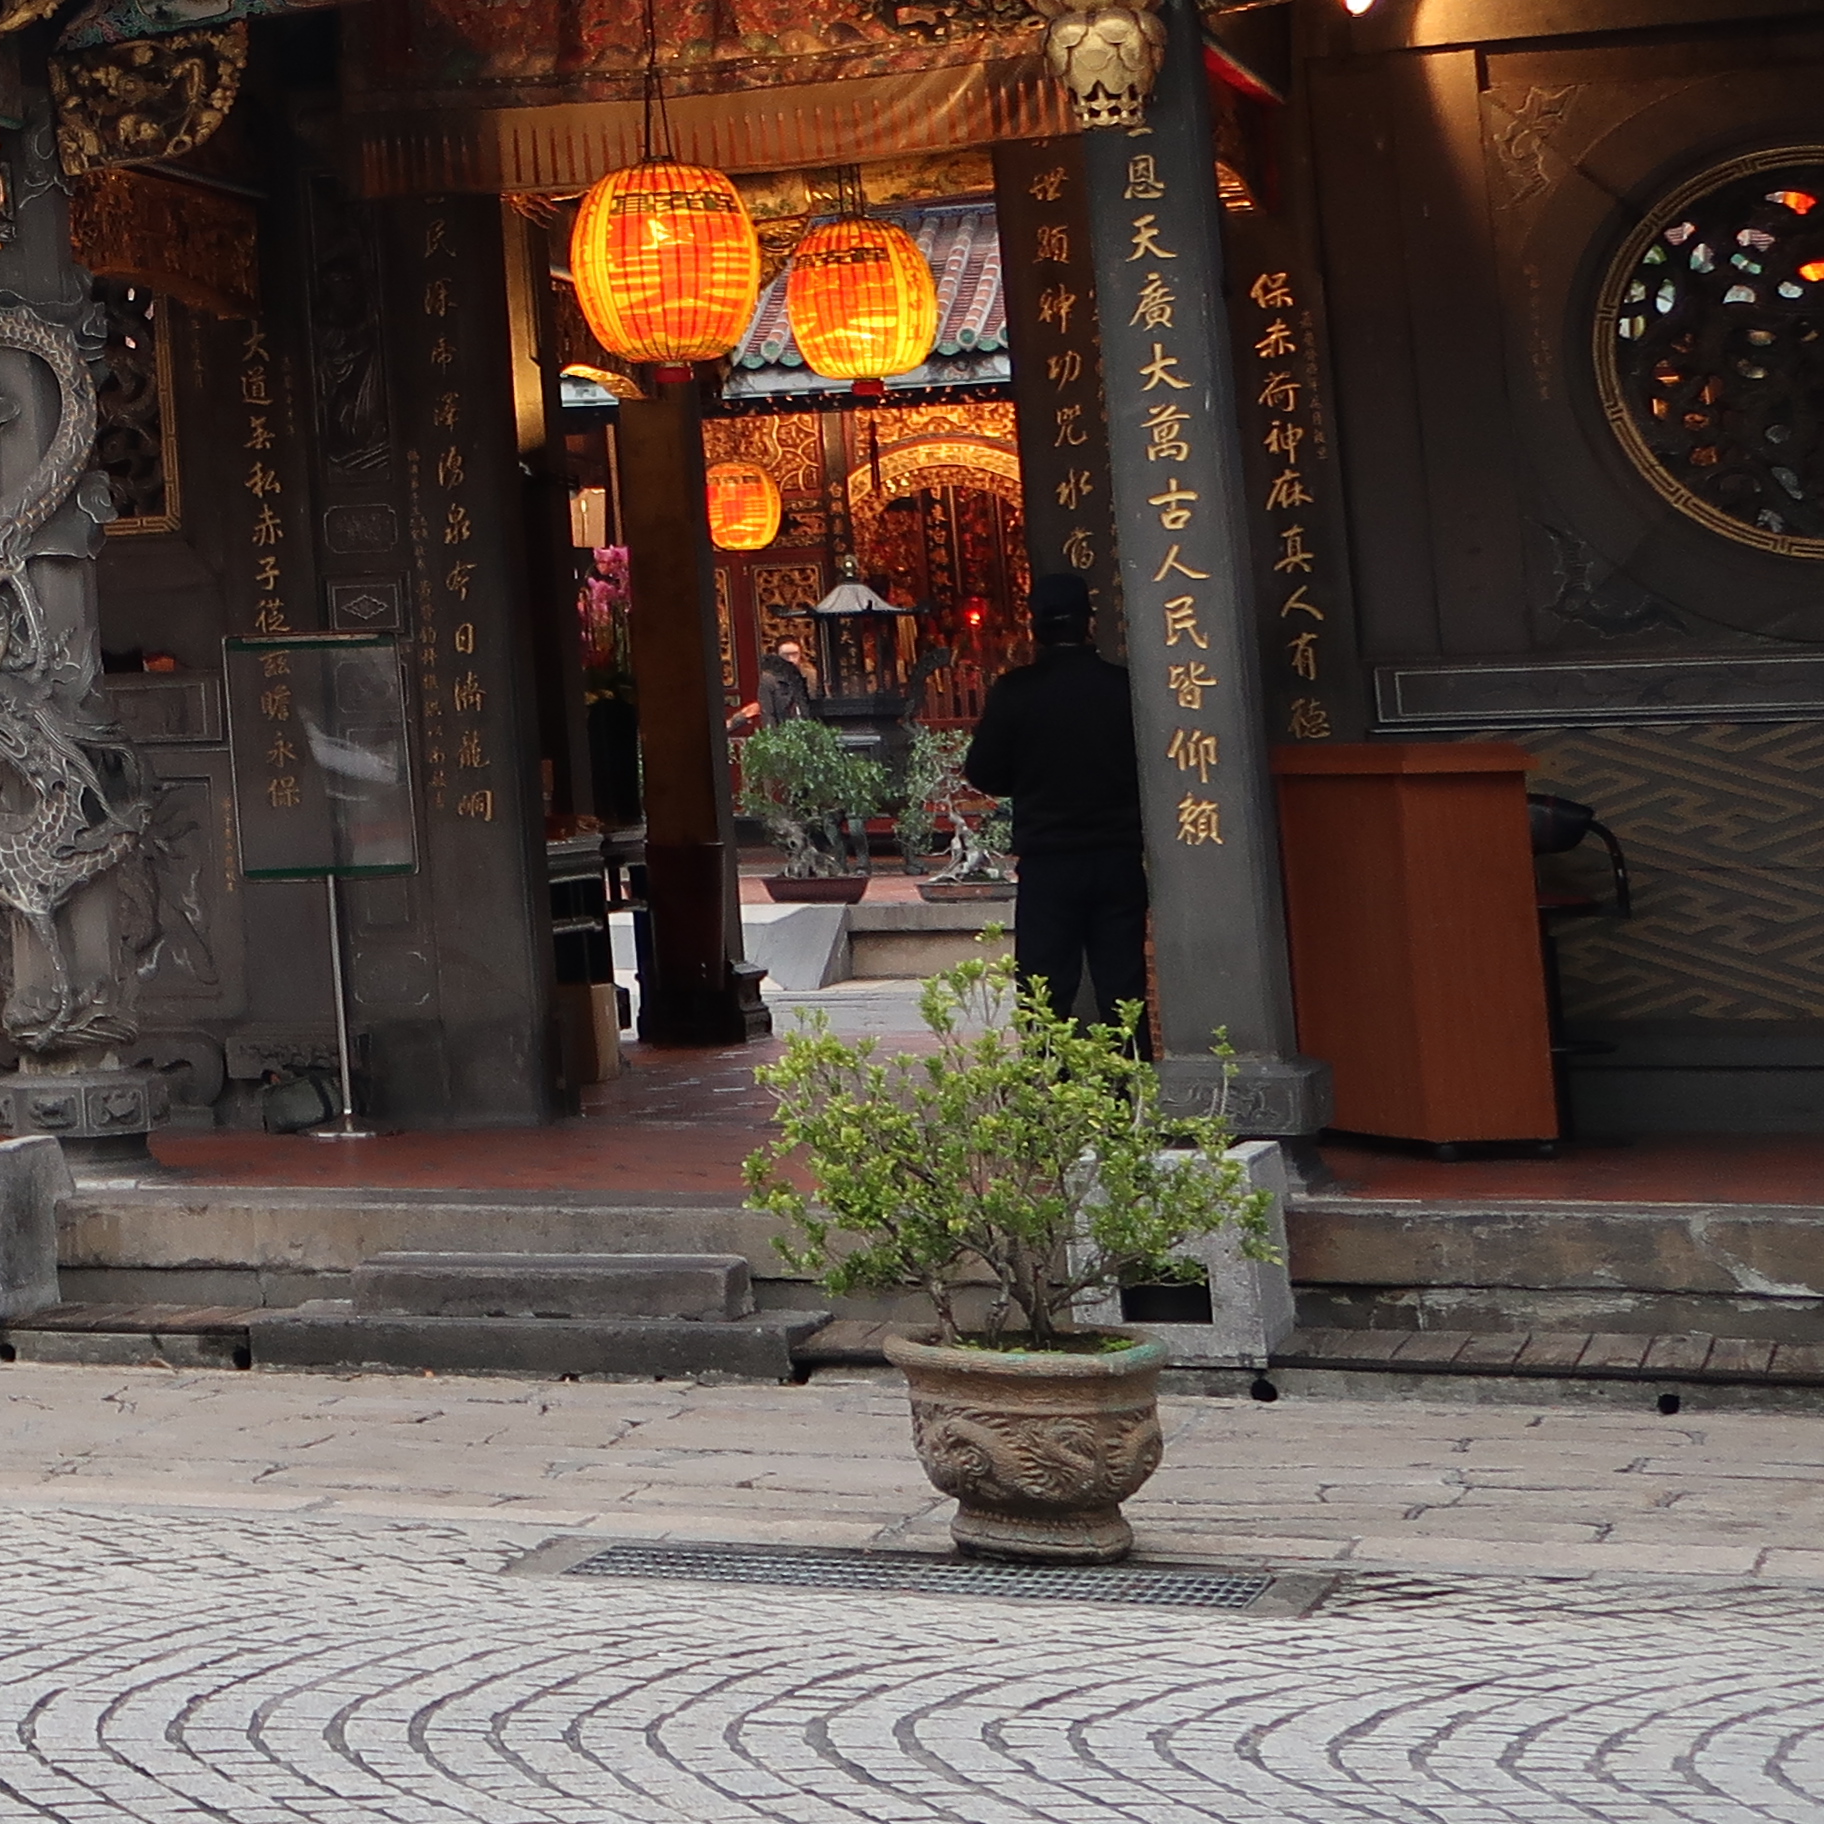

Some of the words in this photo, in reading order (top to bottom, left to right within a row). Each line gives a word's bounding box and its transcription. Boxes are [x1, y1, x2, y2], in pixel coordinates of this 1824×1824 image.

[424, 196, 494, 823] 民深帝澤湧泉今日濟龍峒
[1124, 127, 1225, 847] 恩天廣大萬古人民皆仰賴
